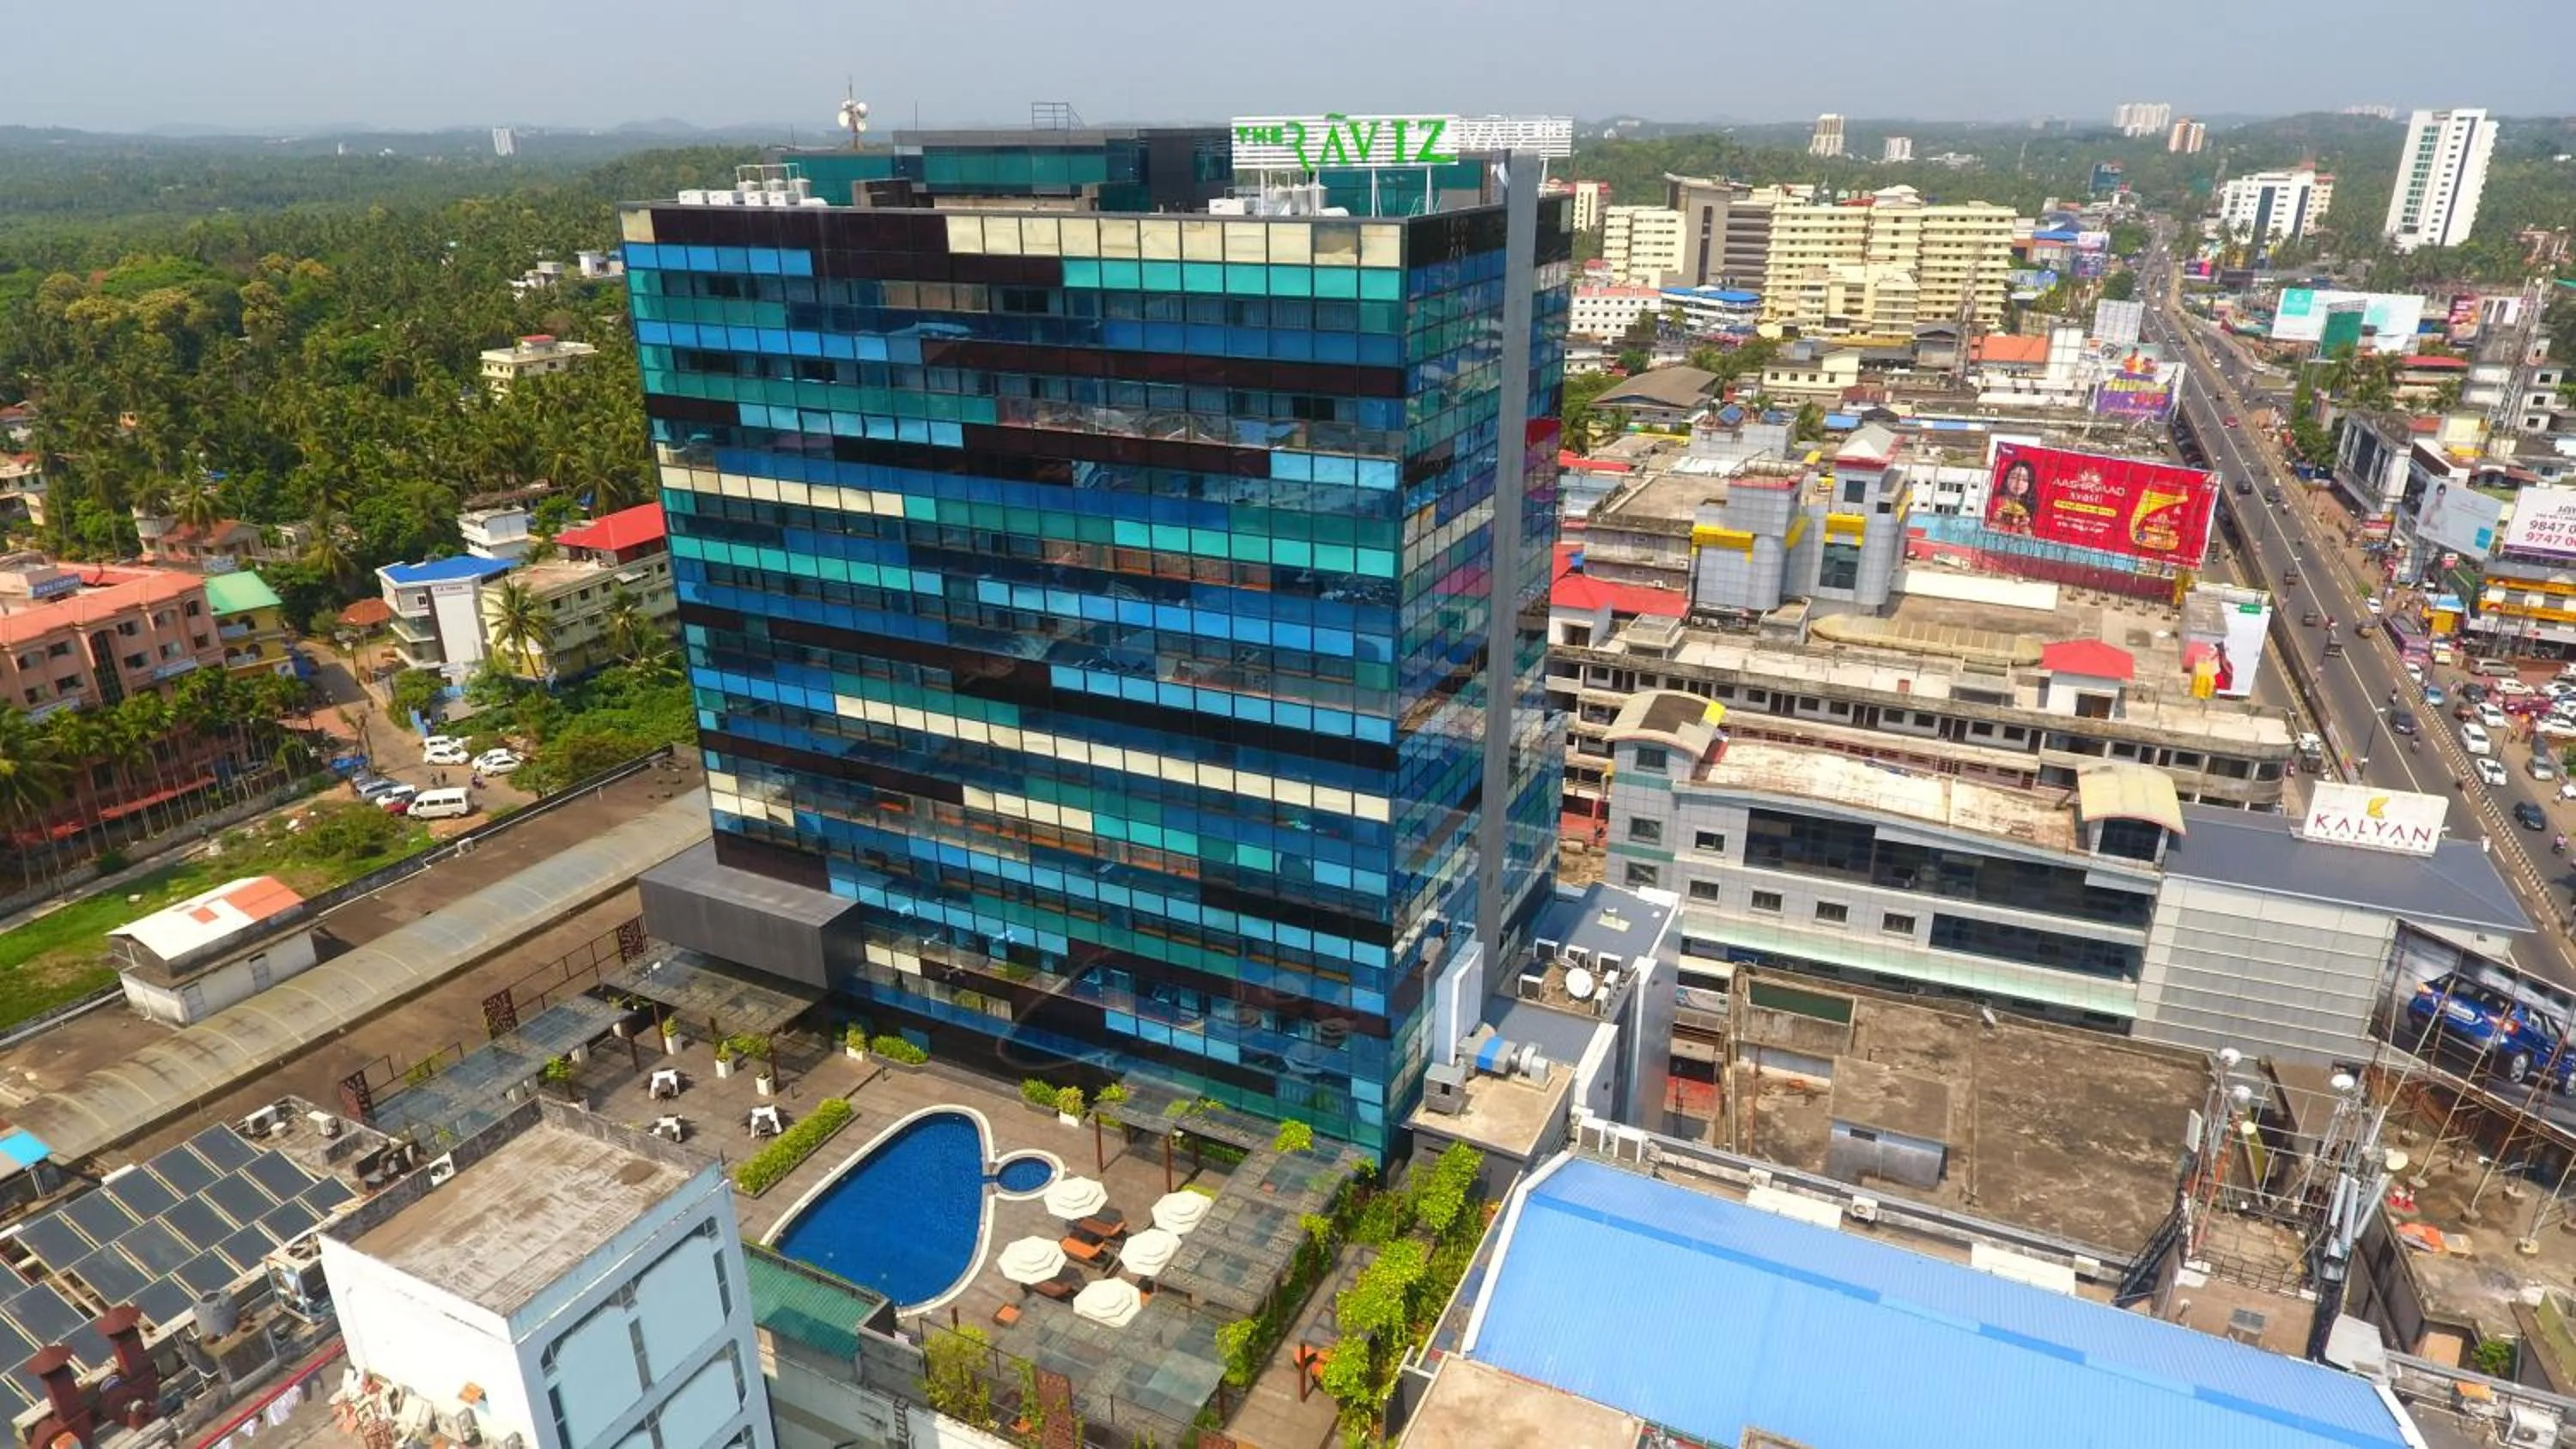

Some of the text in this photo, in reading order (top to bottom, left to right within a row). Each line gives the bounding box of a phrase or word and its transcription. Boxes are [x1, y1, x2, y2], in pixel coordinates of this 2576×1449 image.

[1236, 126, 1283, 144] THE
[2530, 519, 2567, 533] 9847
[2525, 531, 2562, 544] 9747
[2314, 813, 2432, 843] KALYAN
